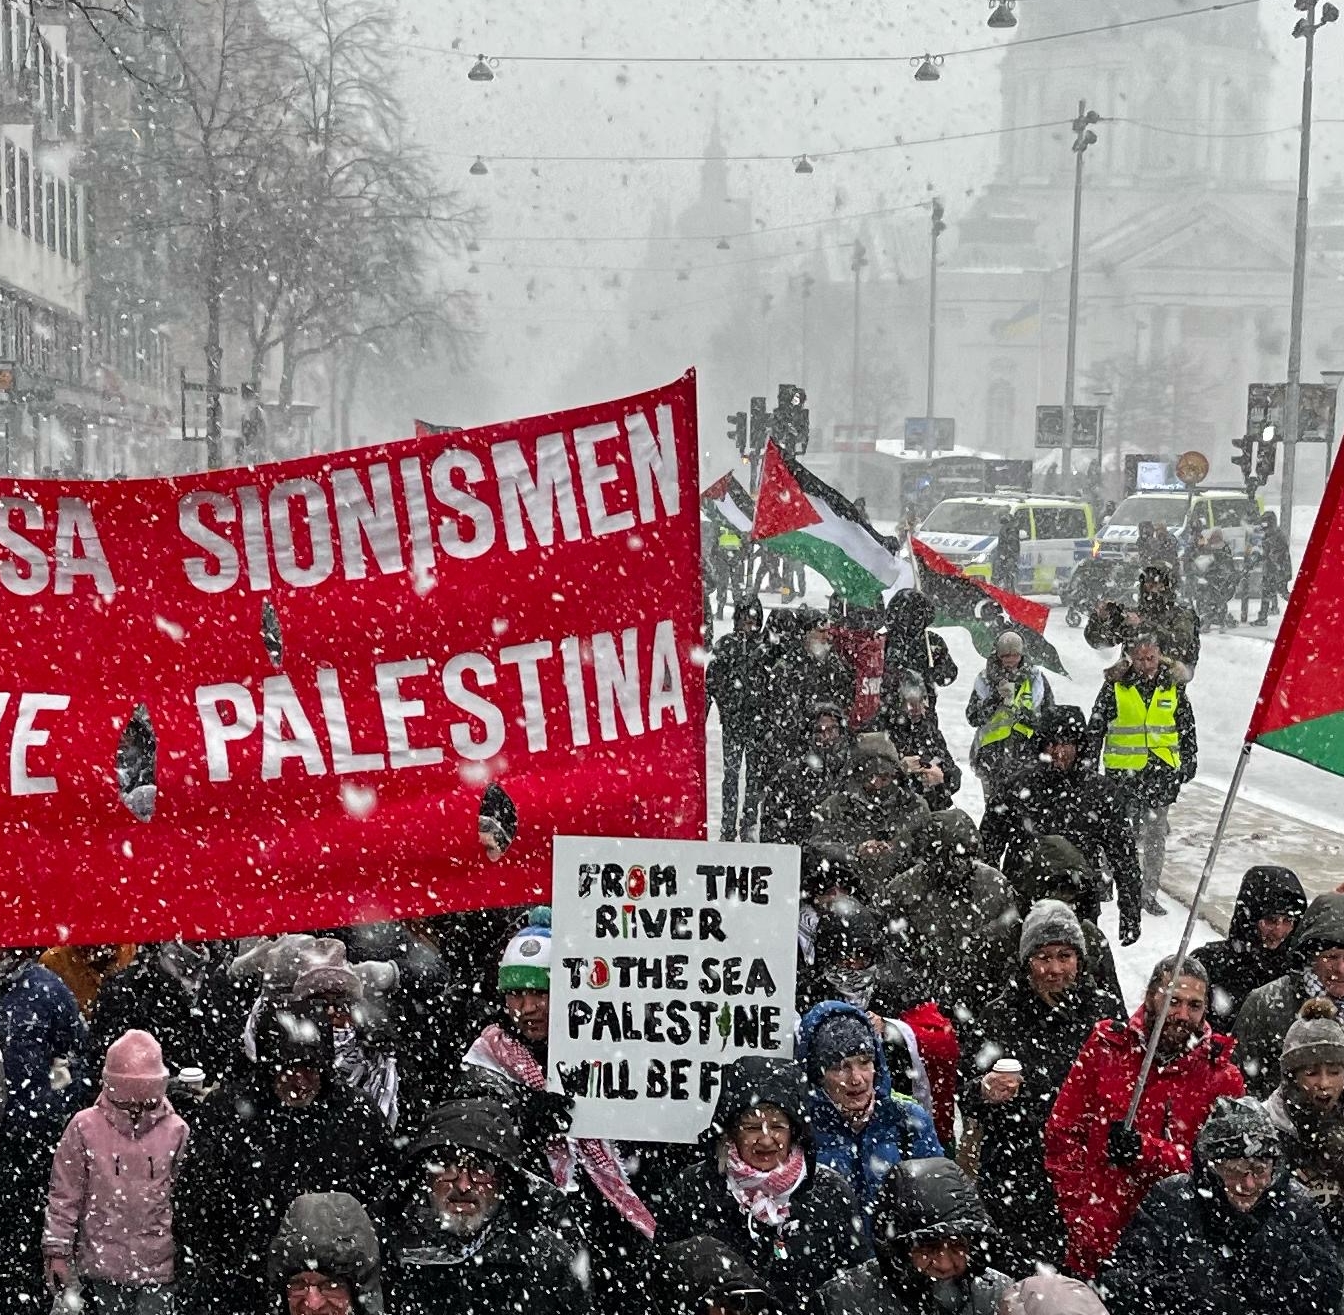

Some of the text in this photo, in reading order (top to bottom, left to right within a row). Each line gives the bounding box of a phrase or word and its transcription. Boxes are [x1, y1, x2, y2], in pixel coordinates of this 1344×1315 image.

[177, 404, 681, 594] SIONISMEN
[194, 619, 688, 783] PALESTINA
[578, 863, 773, 905] FROM THE
[595, 904, 727, 942] RIVER
[698, 956, 776, 997] SEA
[567, 1000, 781, 1052] PALESTINE
[556, 1058, 722, 1103] WILL BE F
